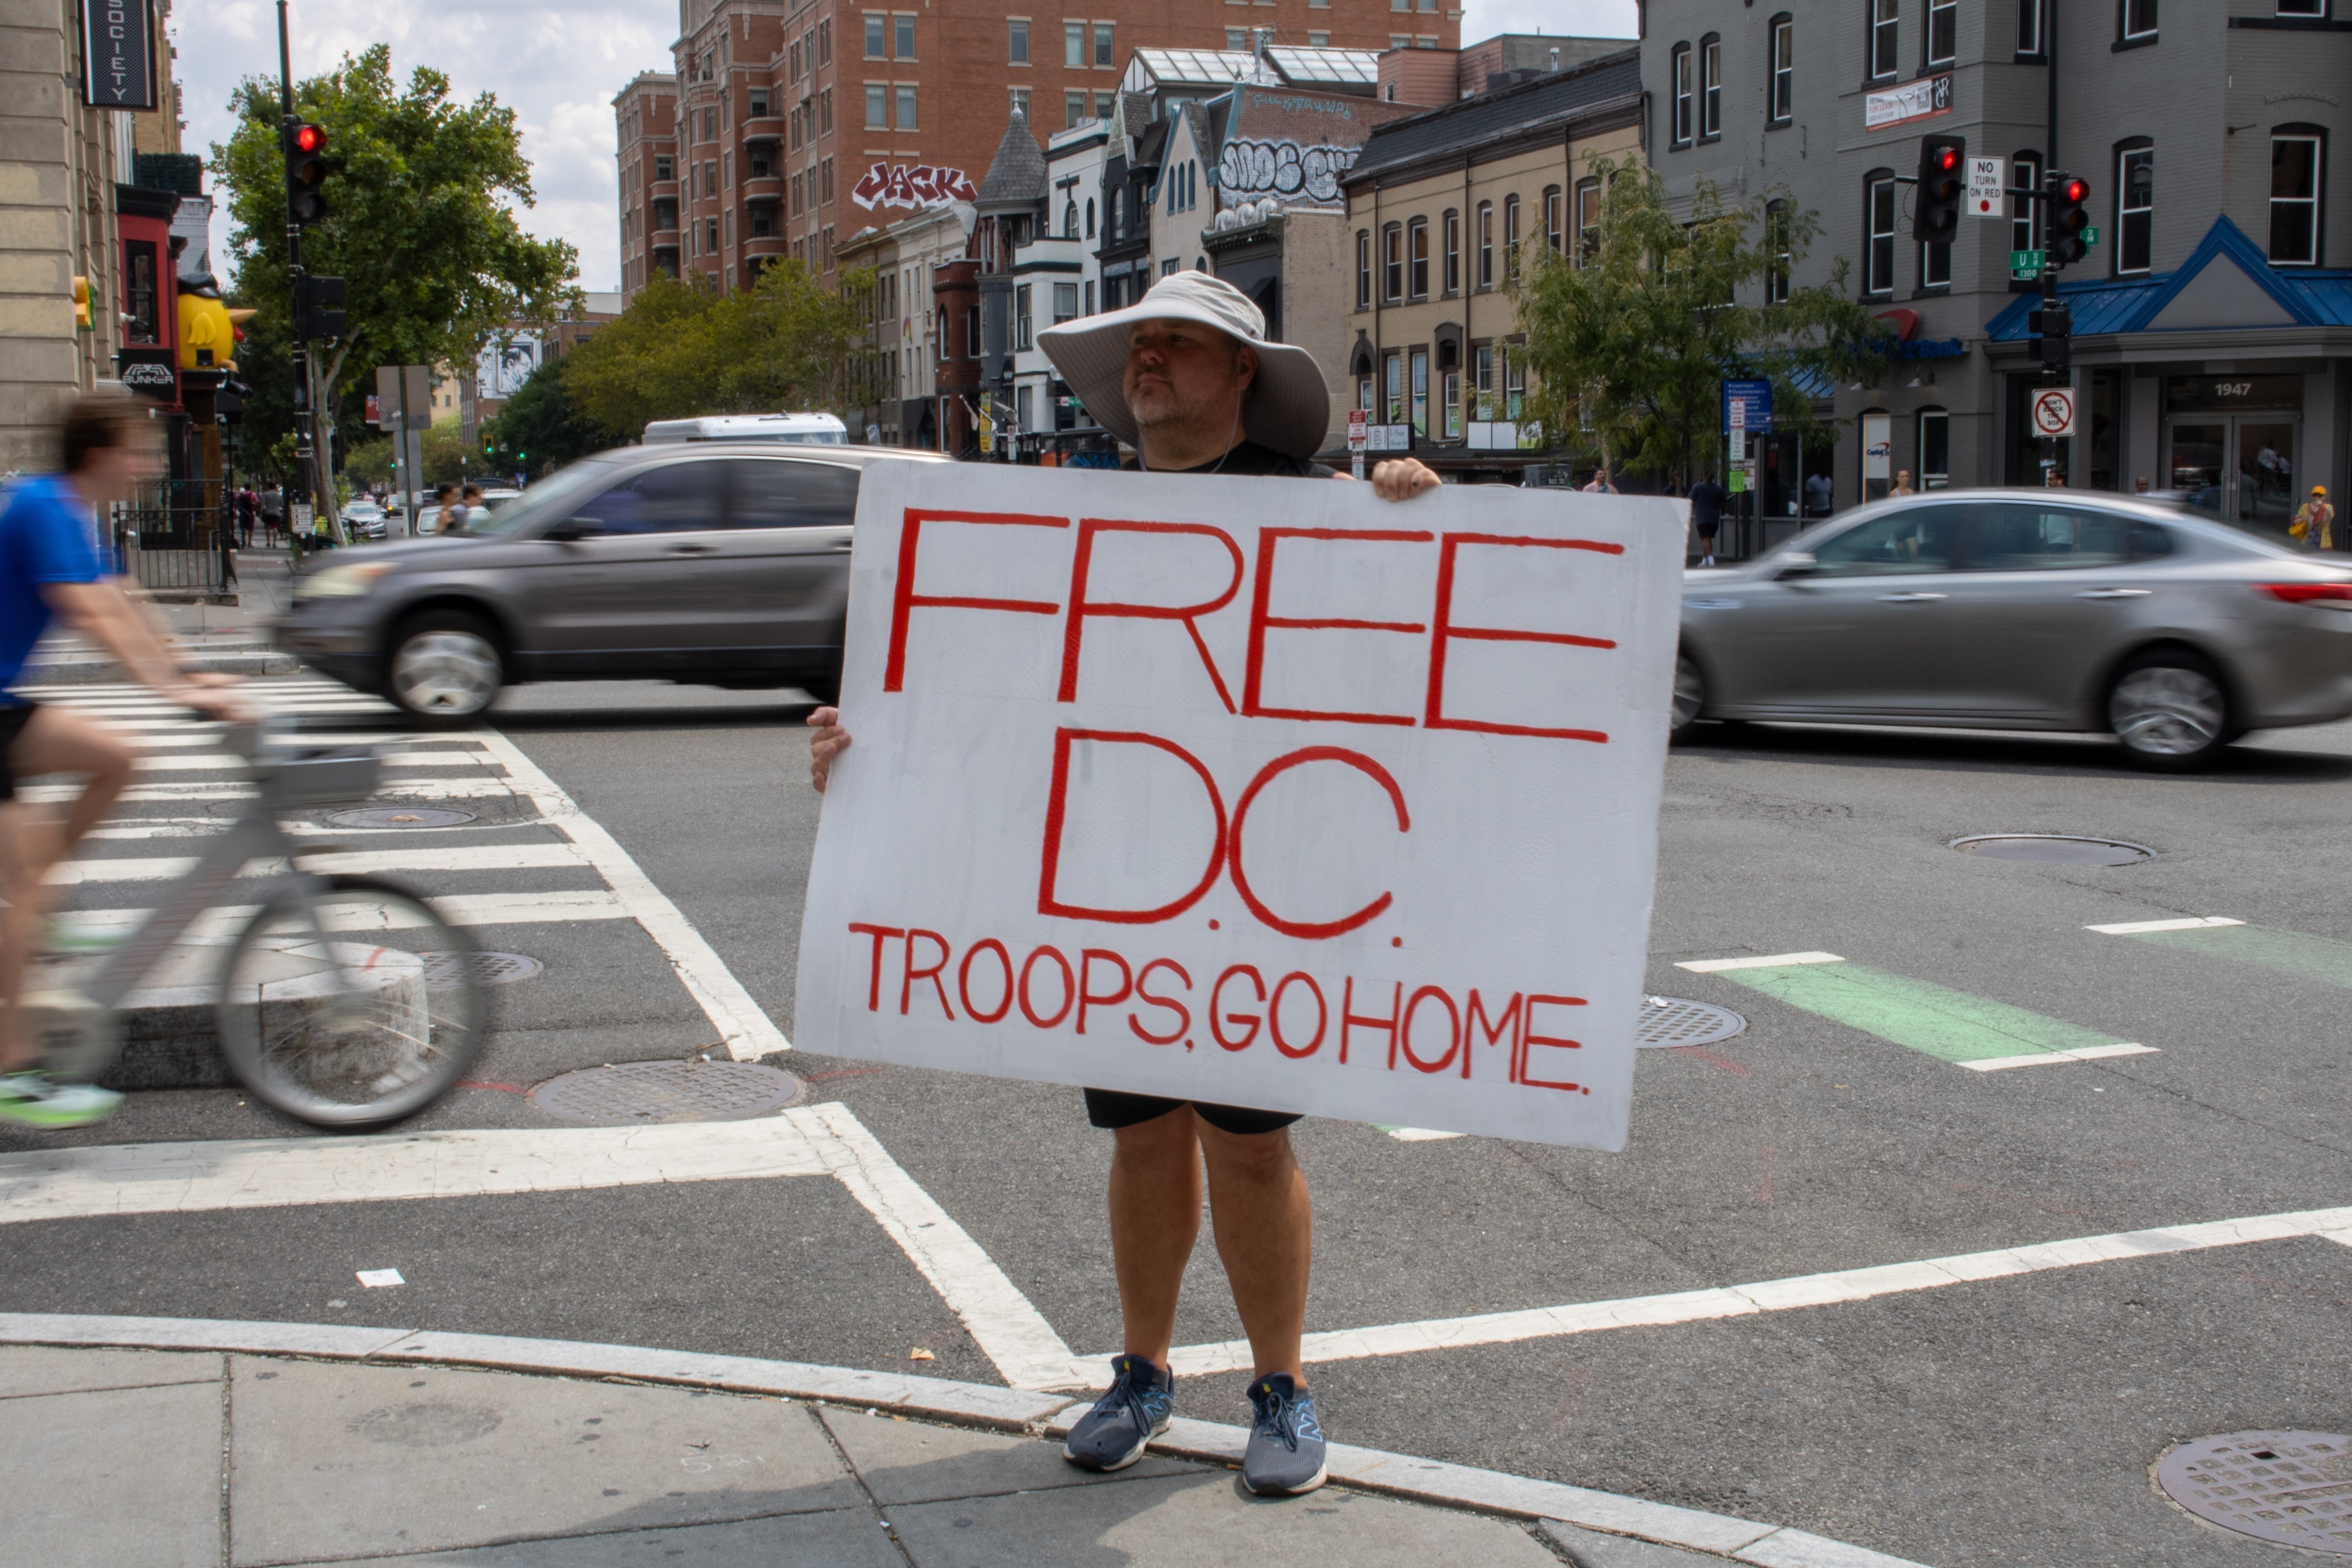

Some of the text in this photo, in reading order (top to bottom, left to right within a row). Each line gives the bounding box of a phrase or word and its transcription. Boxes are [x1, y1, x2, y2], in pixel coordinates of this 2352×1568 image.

[1879, 101, 1894, 111] LEASE
[1977, 162, 1994, 173] NO
[852, 161, 978, 212] JACK
[1975, 176, 1996, 186] TURN
[1970, 188, 2001, 198] ON RED
[2020, 253, 2027, 266] U
[2020, 269, 2037, 277] 1300
[123, 375, 174, 384] BUNKER
[2215, 383, 2251, 396] 1947
[884, 508, 1623, 743] FREE
[1038, 727, 1409, 947] D.C.
[1210, 964, 1326, 1058] GO
[1340, 977, 1590, 1096] HOME.
